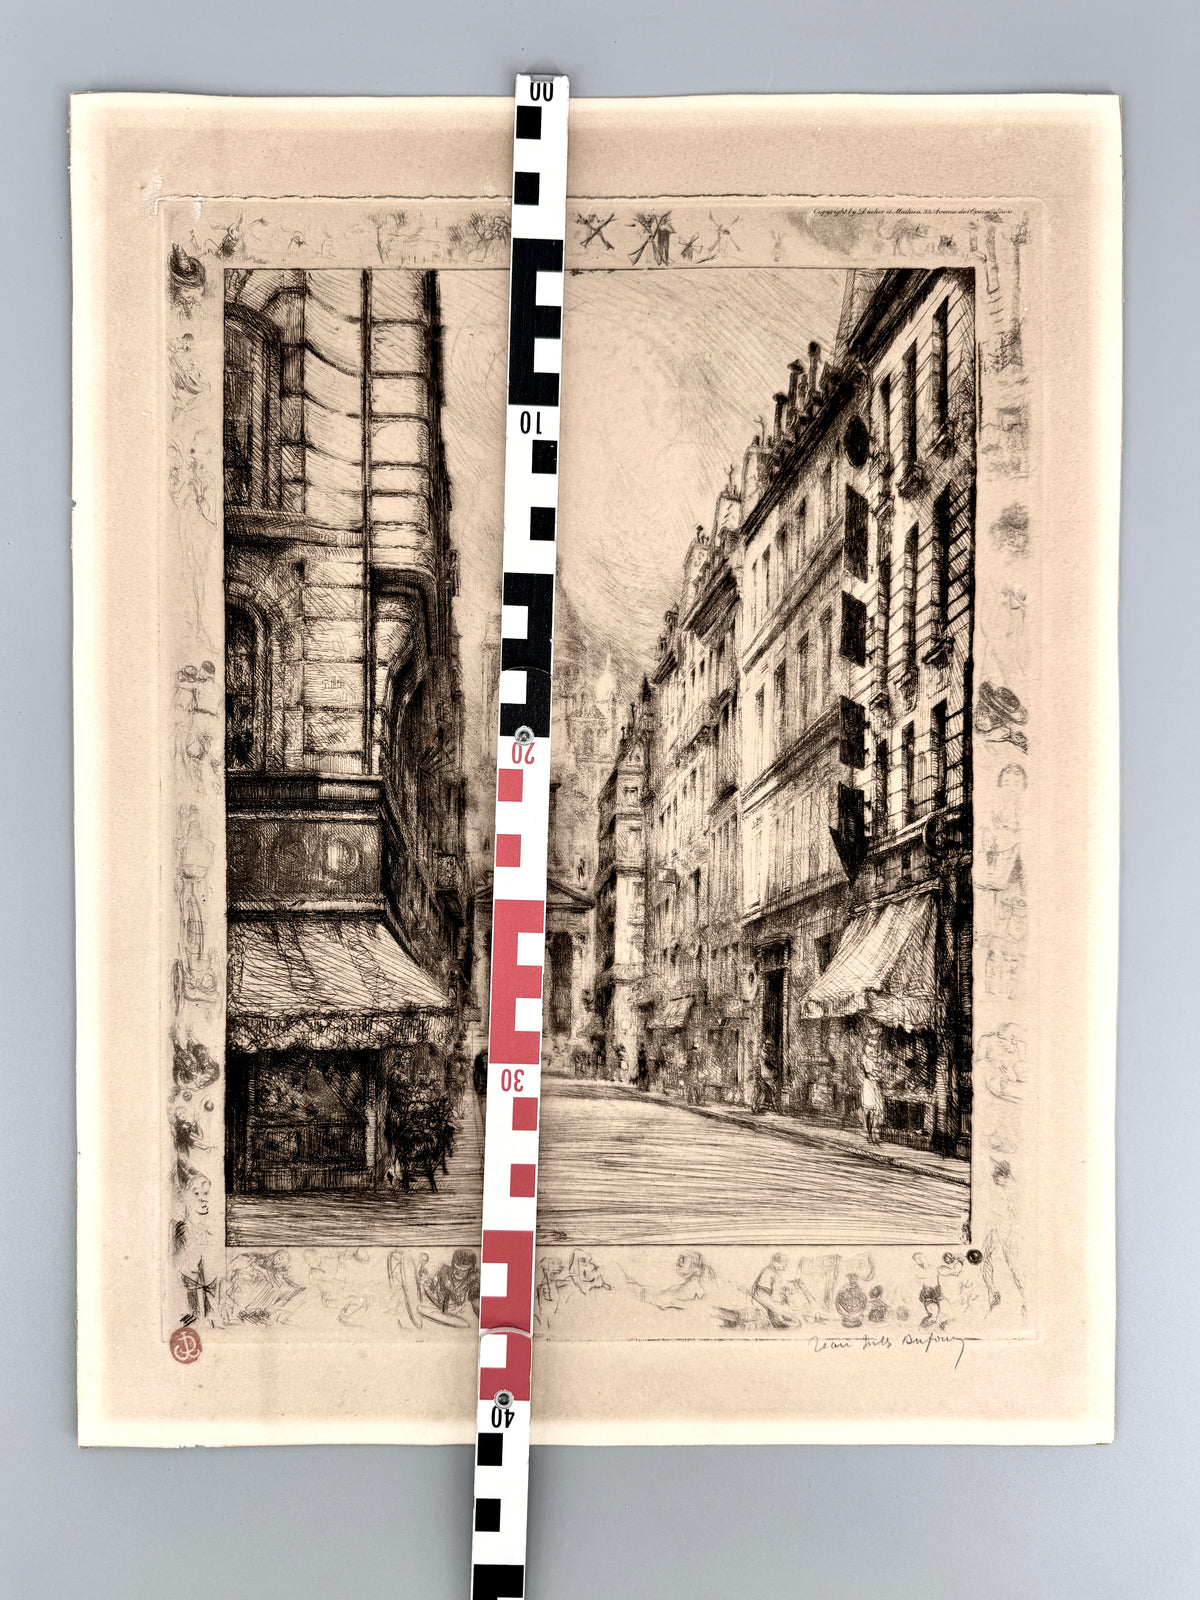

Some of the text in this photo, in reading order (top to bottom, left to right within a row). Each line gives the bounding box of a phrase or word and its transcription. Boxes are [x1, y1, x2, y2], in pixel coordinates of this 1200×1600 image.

[529, 82, 553, 101] 00
[813, 207, 848, 217] Copyright
[848, 207, 857, 217] by
[520, 410, 542, 435] 10
[511, 741, 535, 765] 20
[500, 1068, 525, 1092] 30
[491, 1405, 515, 1428] 40
